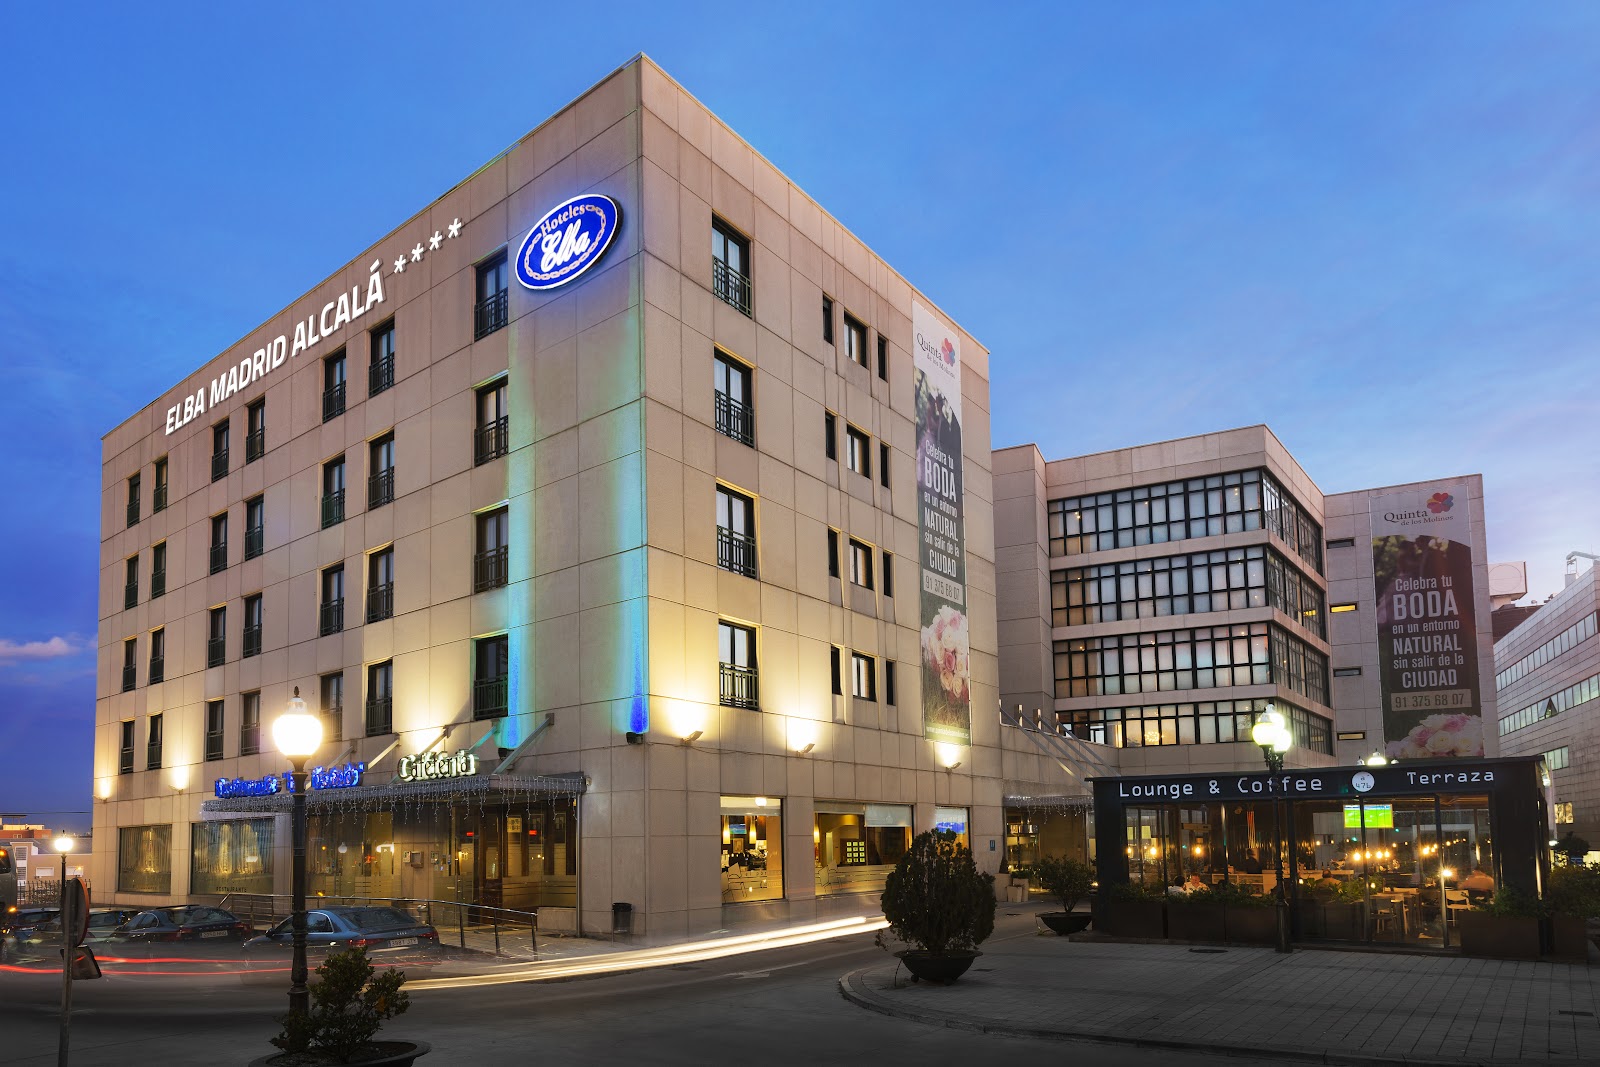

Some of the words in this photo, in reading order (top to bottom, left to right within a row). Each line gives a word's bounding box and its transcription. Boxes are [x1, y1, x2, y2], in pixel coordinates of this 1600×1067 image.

[540, 204, 585, 238] Hoteles
[540, 218, 590, 273] Elba
[165, 387, 206, 436] ELBA
[209, 334, 288, 408] MADRID
[291, 258, 384, 357] ALCALÁ
[916, 332, 943, 362] Quinta
[925, 439, 947, 466] Celebra
[948, 454, 954, 470] tu
[924, 455, 957, 503] BODA
[924, 491, 931, 504] en
[931, 495, 939, 508] un
[939, 499, 958, 518] entorno
[1384, 510, 1428, 523] Quinta
[924, 506, 959, 542] NATURAL
[1423, 515, 1454, 524] Molinos
[924, 530, 933, 545] sin
[934, 535, 946, 551] salir
[946, 540, 954, 555] de
[954, 542, 960, 558] la
[929, 548, 957, 578] CIUDAD
[925, 575, 933, 590] 91
[934, 578, 944, 595] 375
[1395, 576, 1438, 592] Celebra
[1440, 574, 1453, 588] tu
[1392, 588, 1459, 621] BODA
[1392, 624, 1404, 635] en
[1407, 623, 1419, 634] un
[1422, 619, 1460, 632] entorno
[1392, 633, 1463, 656] NATURAL
[1393, 656, 1409, 670] sin
[1411, 654, 1435, 668] salir
[1438, 653, 1451, 667] de
[1454, 652, 1464, 666] la
[1402, 668, 1458, 689] CIUDAD
[1395, 696, 1407, 709] 91
[1411, 695, 1431, 708] 375
[1434, 693, 1448, 707] 68
[1452, 693, 1465, 706] 07
[1119, 782, 1194, 800] Lounge
[1208, 779, 1220, 795] &
[1237, 776, 1323, 794] Coffee
[1406, 771, 1495, 785] Terraza
